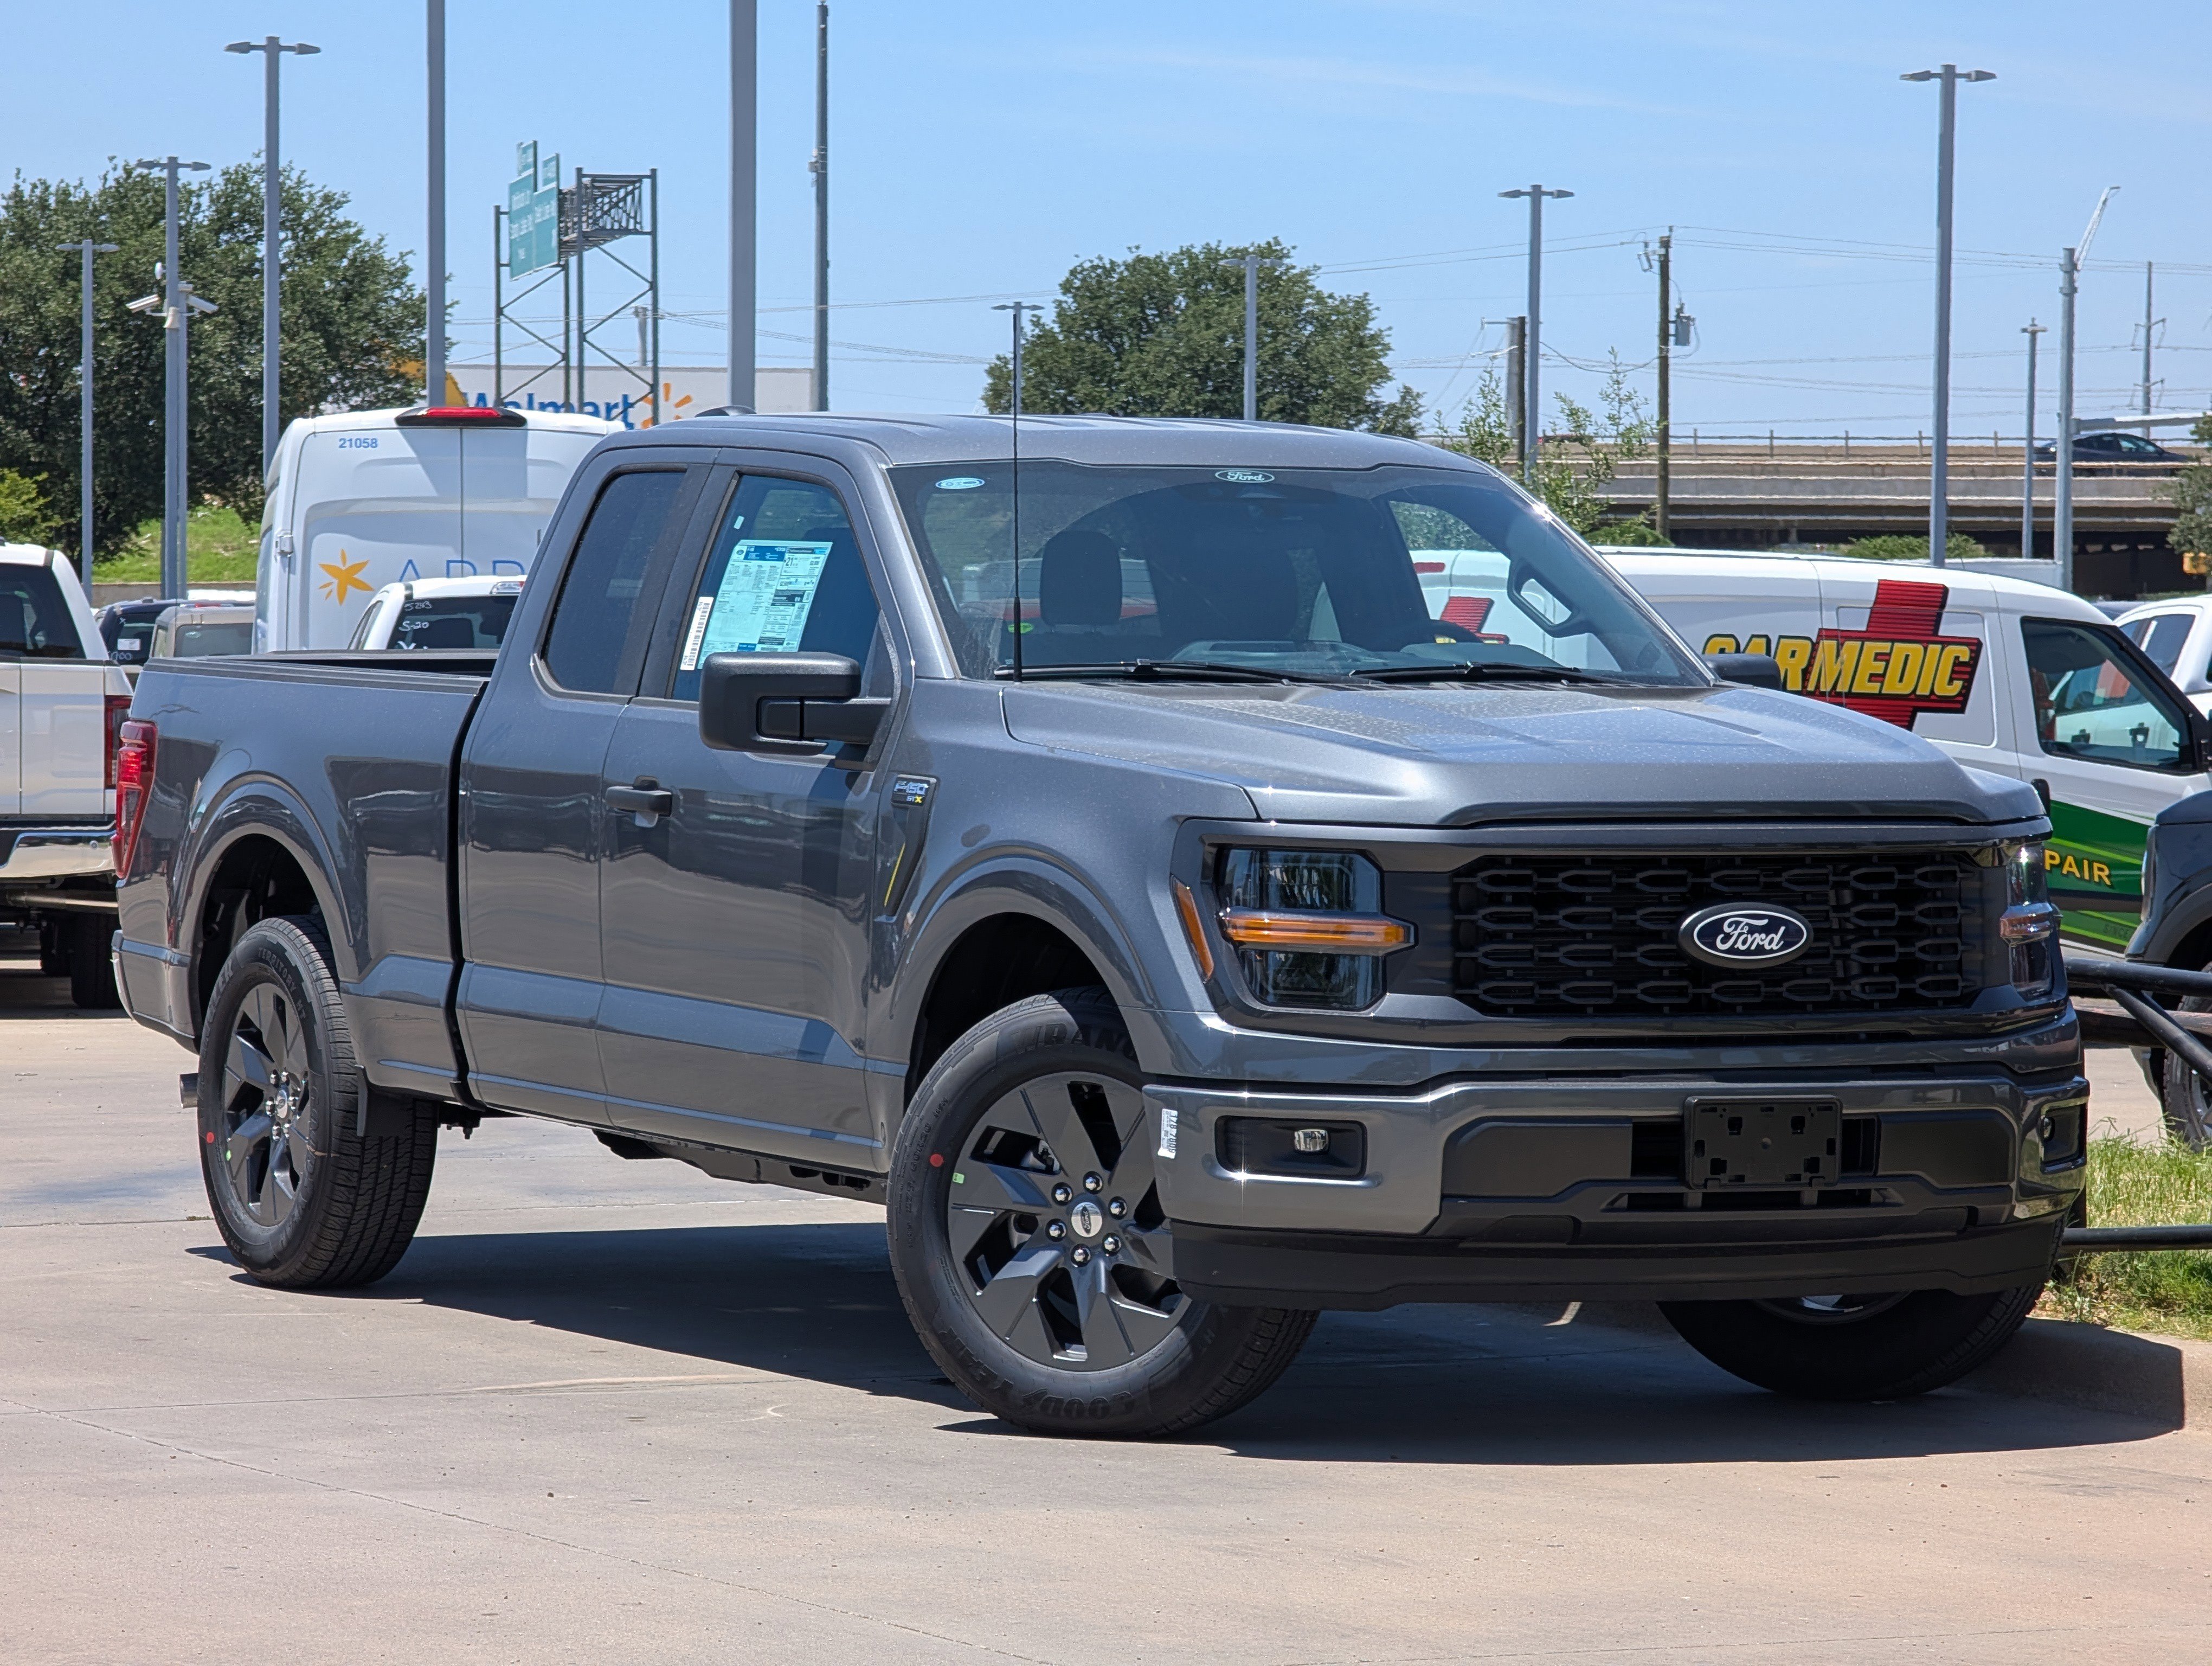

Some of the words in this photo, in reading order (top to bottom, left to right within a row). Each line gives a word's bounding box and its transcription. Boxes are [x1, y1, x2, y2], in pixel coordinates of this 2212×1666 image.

[338, 438, 378, 448] 21058
[1227, 471, 1265, 482] Ford
[906, 795, 923, 804] STX
[2044, 849, 2111, 886] PAIR
[1716, 917, 1786, 950] Ford
[258, 947, 298, 992] TERRITORY
[939, 1327, 1134, 1421] GOODYEAR
